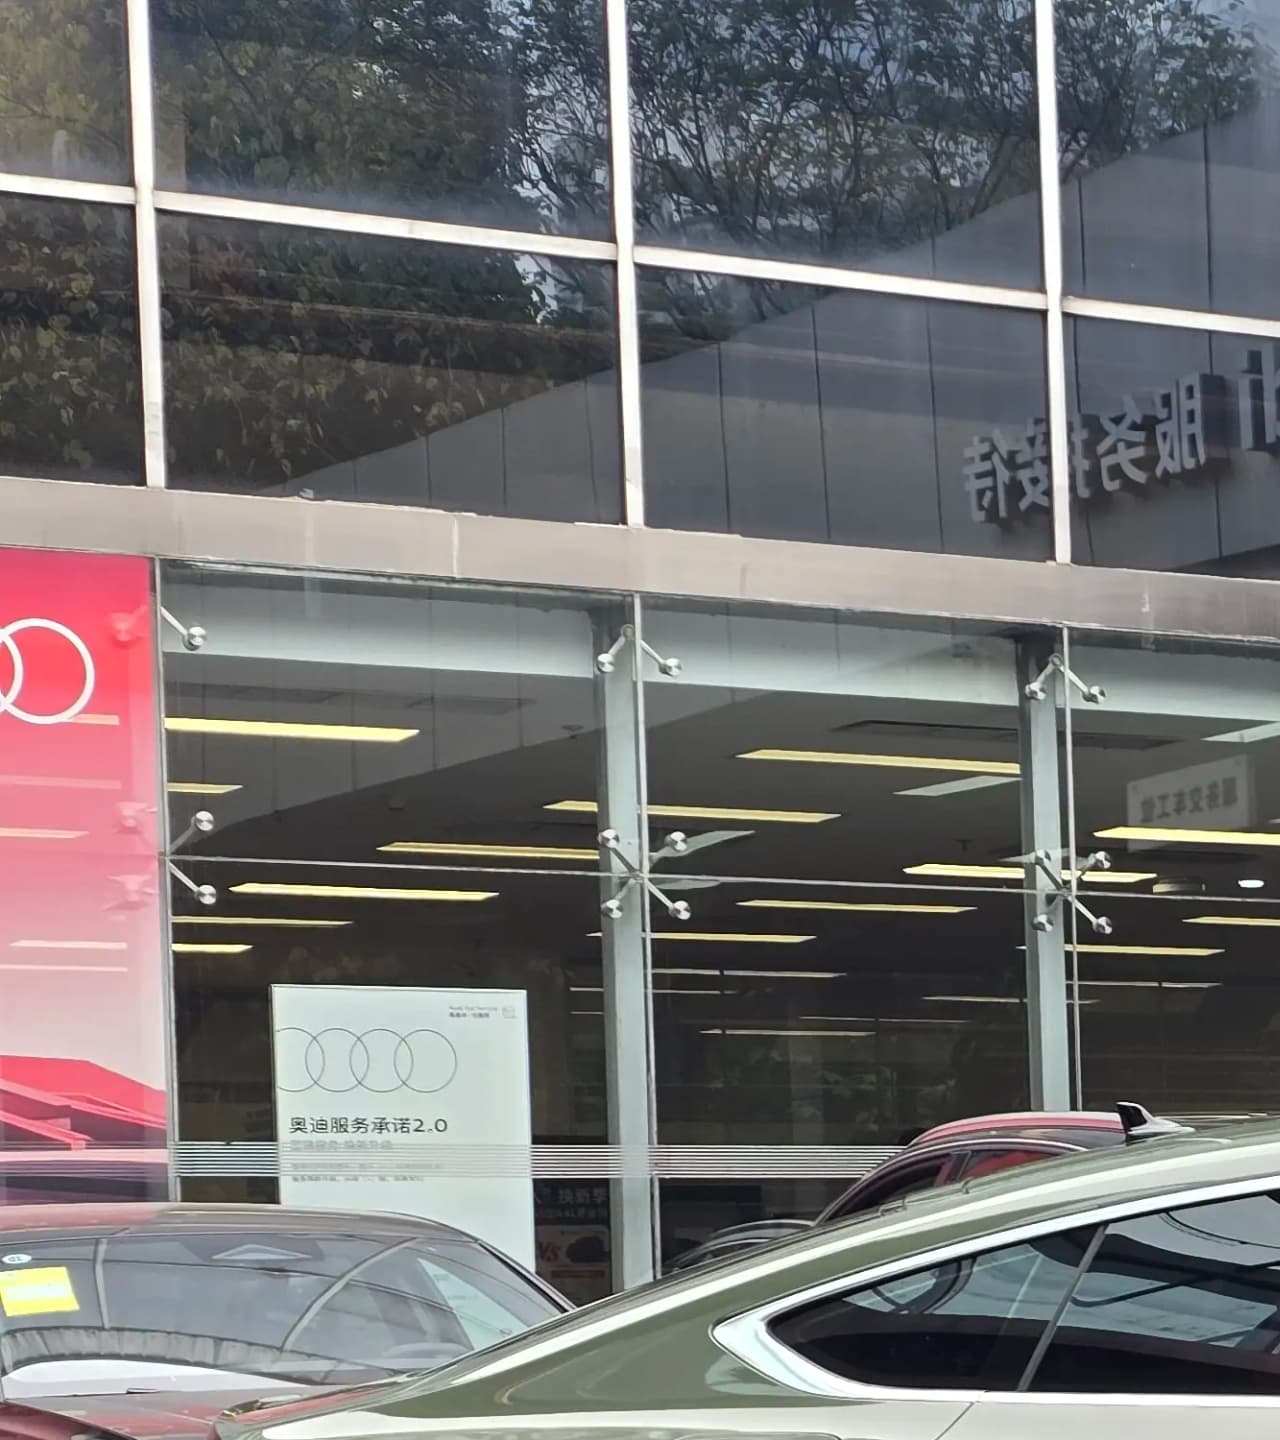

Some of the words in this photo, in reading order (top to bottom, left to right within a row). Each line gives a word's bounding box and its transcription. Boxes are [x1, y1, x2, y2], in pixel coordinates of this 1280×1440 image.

[289, 1116, 449, 1135] 奥迪服务承诺2.0
